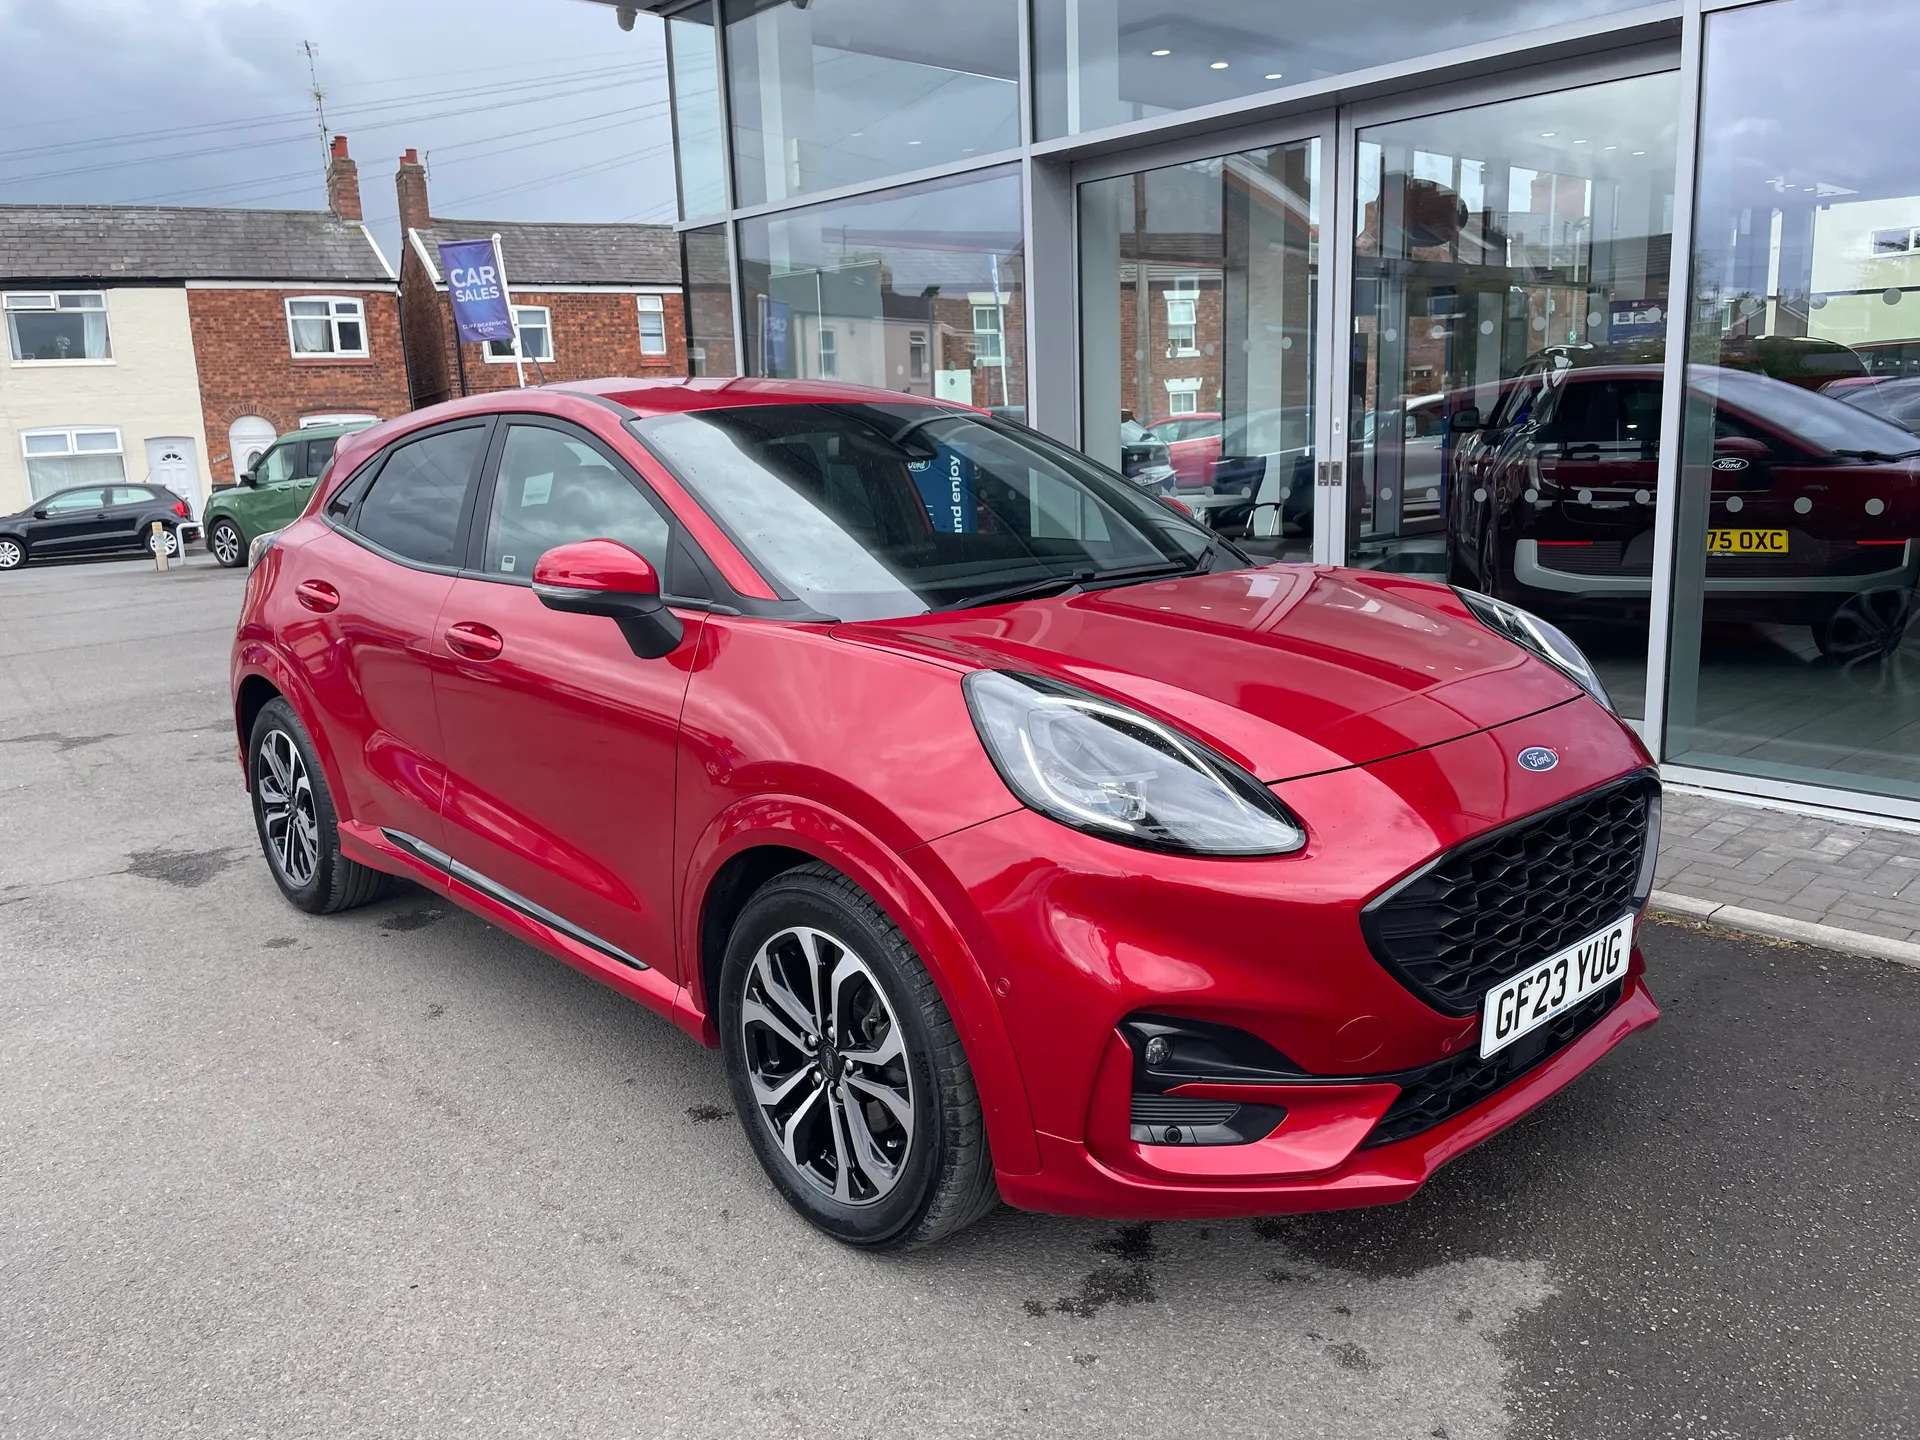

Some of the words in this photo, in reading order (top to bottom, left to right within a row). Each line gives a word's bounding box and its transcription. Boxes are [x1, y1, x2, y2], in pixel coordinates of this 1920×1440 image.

[450, 265, 496, 288] CAR
[455, 286, 500, 303] SALES
[1718, 460, 1742, 469] Ford
[949, 455, 962, 503] enjoy
[1708, 531, 1732, 549] 75
[1740, 531, 1783, 550] OXC
[1527, 752, 1551, 767] Ford
[1496, 958, 1569, 1040] GF23
[1577, 928, 1622, 993] YUG
